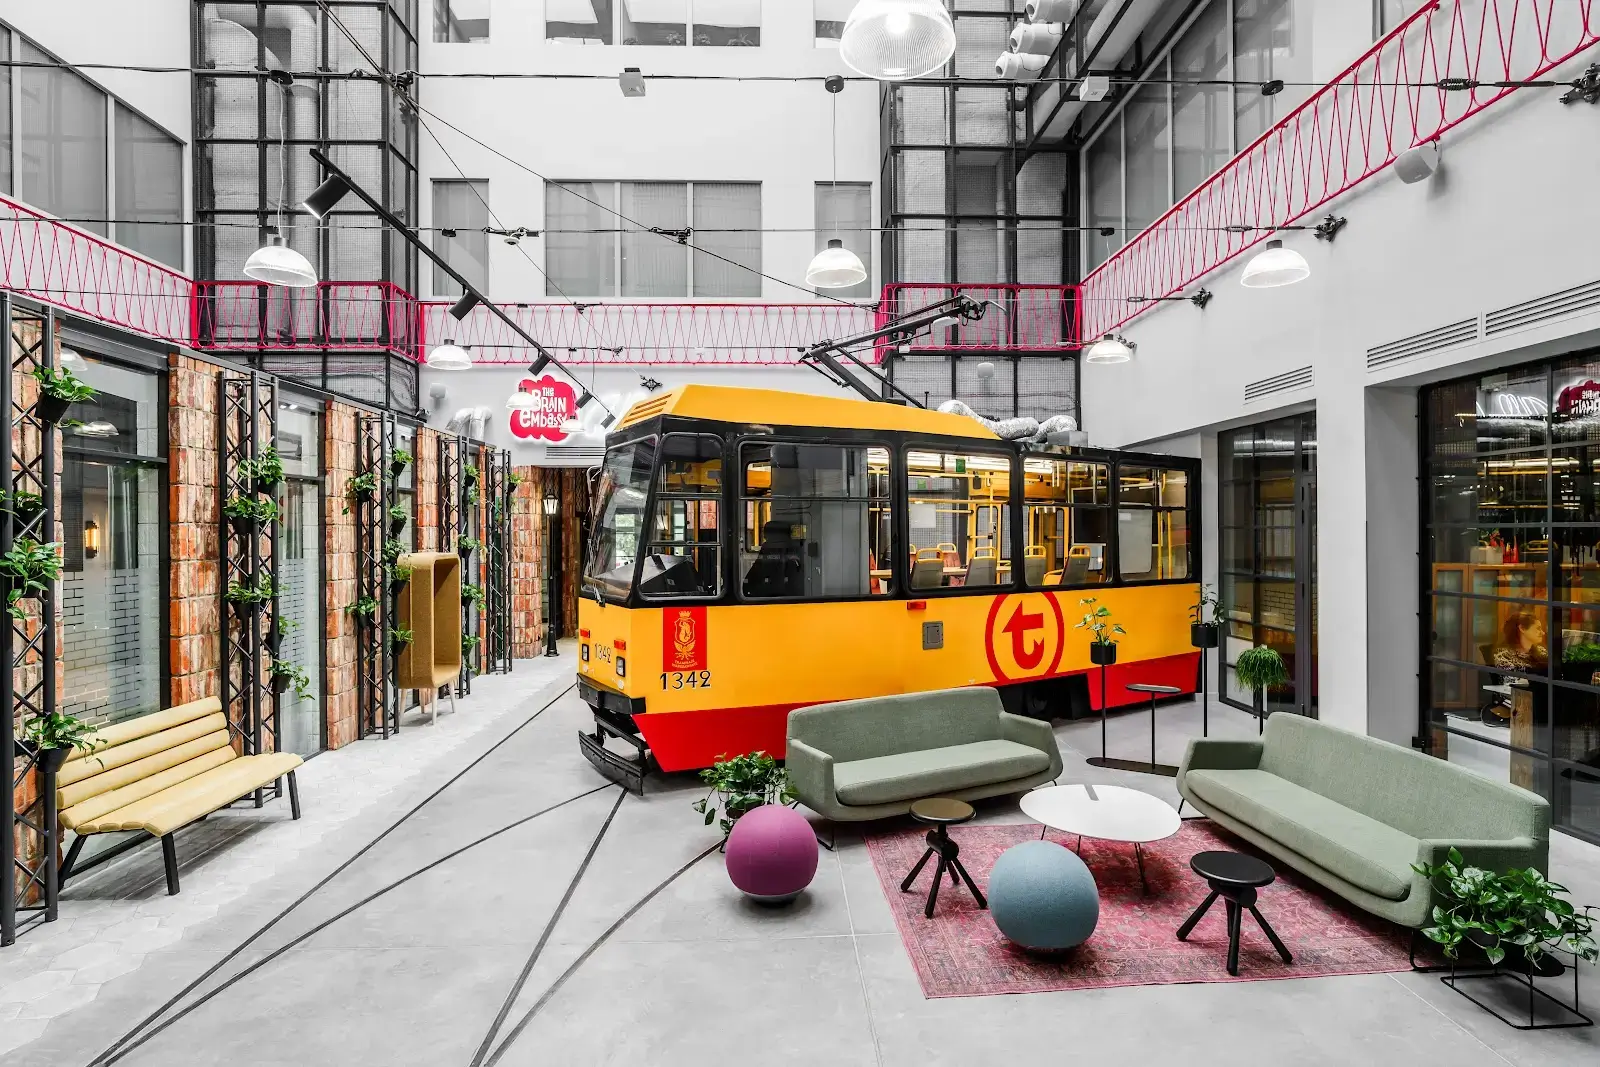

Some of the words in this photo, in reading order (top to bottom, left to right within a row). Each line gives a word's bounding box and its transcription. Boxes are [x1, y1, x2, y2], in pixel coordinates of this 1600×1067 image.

[531, 389, 566, 413] BRAIN
[595, 642, 611, 664] 1342
[659, 670, 711, 690] 1342
